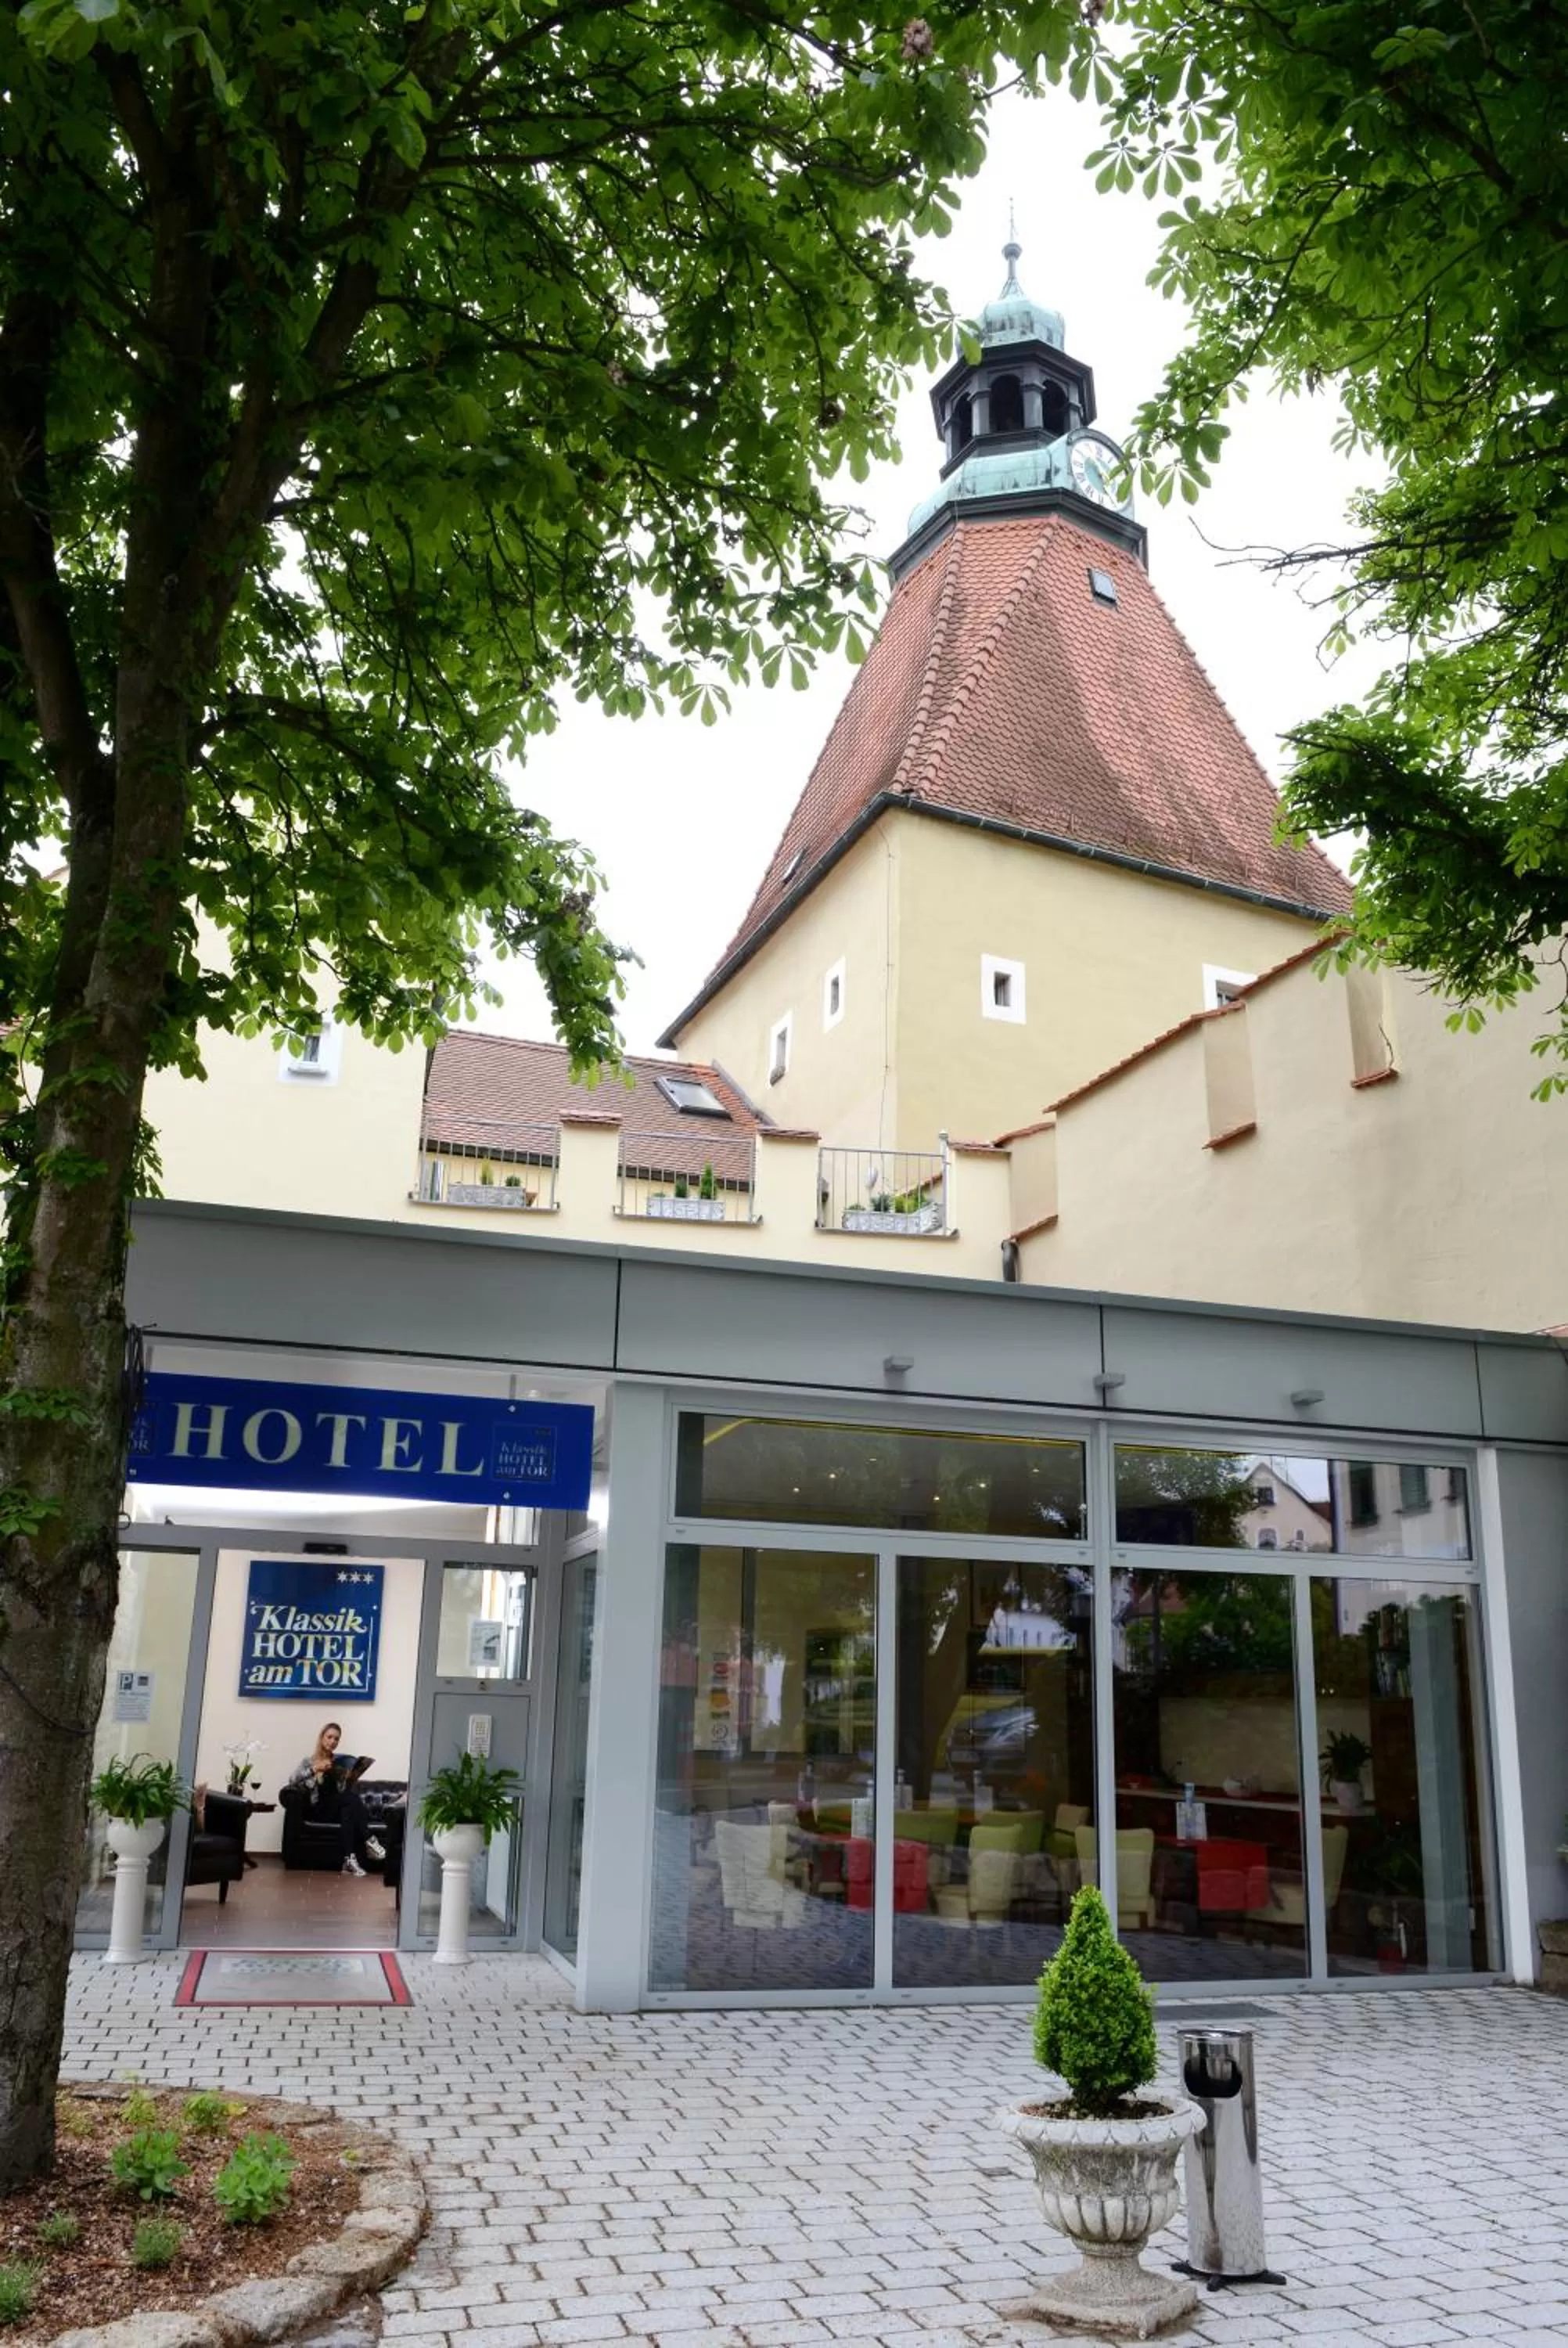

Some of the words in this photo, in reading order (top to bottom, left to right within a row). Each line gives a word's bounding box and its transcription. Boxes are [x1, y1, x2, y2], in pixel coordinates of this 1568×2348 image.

[164, 1402, 484, 1477] HOTEL
[250, 1604, 368, 1633] Klassik
[251, 1632, 365, 1661] HOTEL
[248, 1665, 293, 1684] am
[296, 1659, 364, 1687] TOR
